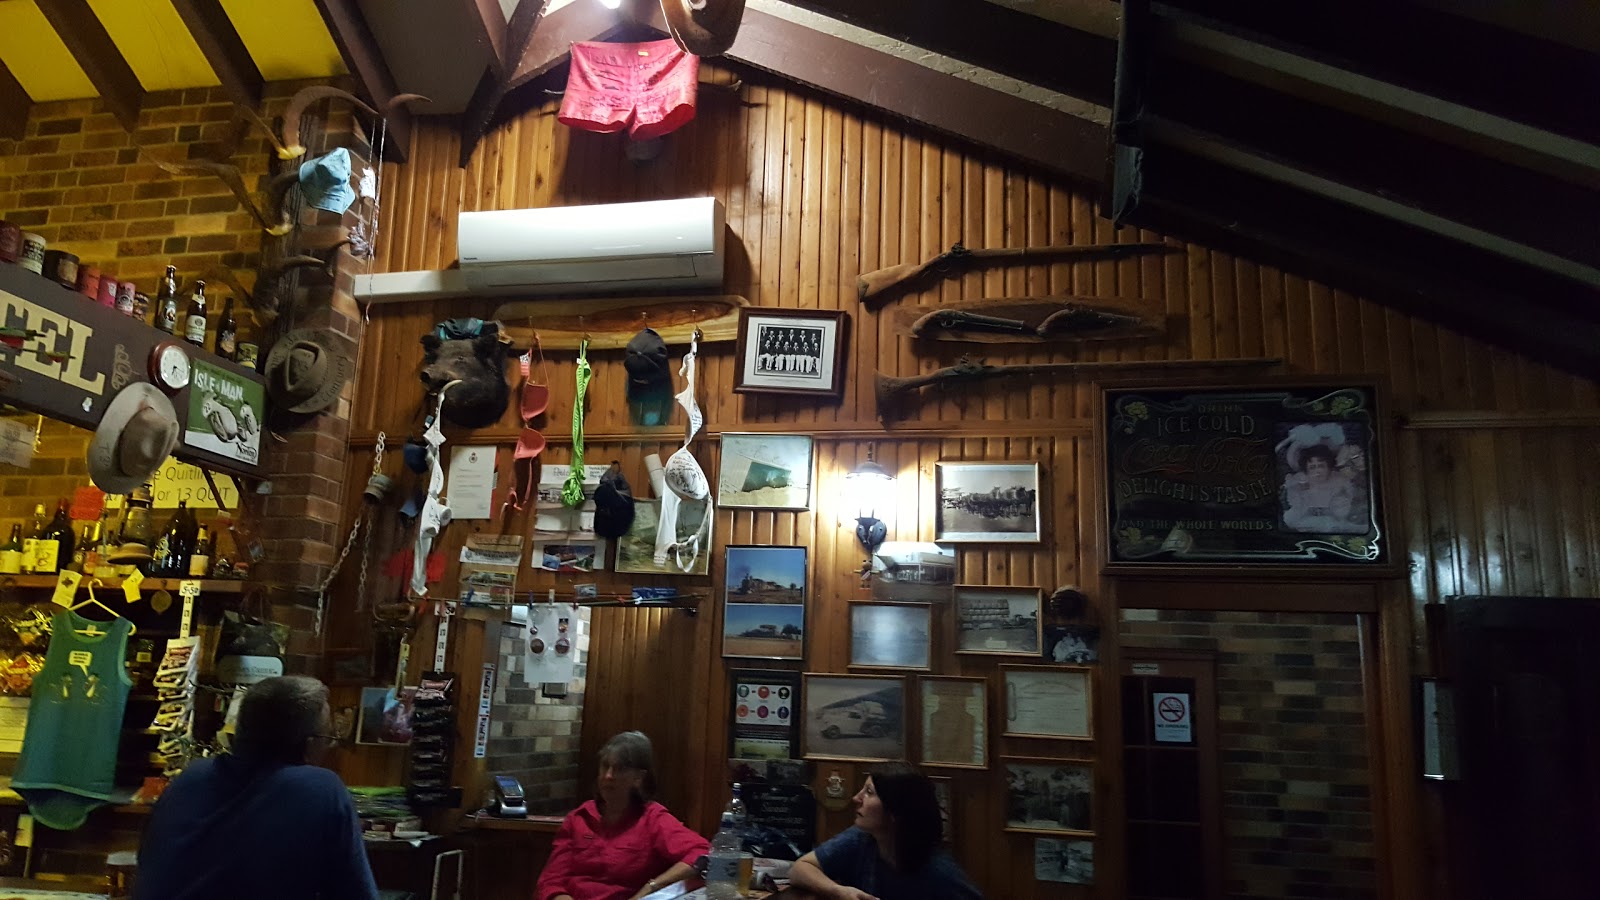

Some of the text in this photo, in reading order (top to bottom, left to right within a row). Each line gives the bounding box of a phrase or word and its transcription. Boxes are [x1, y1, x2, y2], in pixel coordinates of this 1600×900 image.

[194, 368, 216, 392] ISLE
[220, 379, 243, 402] MAN
[1157, 414, 1255, 437] ICE COLD
[157, 489, 170, 501] or
[177, 487, 192, 500] 13
[1150, 520, 1169, 528] THE
[1175, 519, 1217, 529] WHOLE
